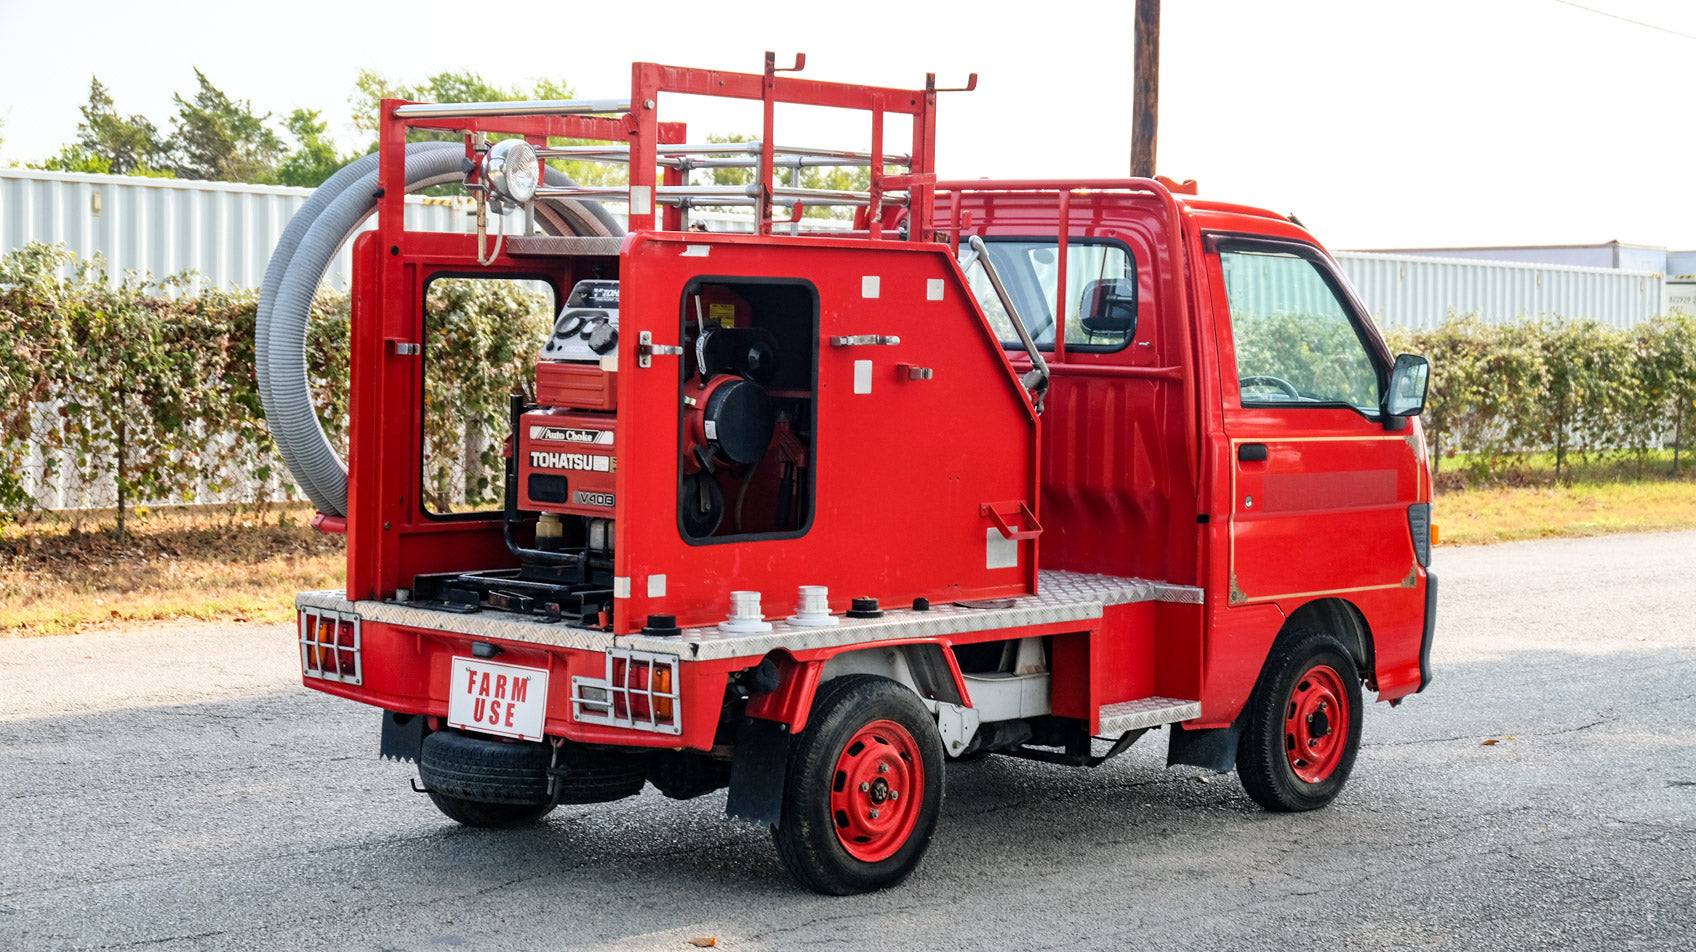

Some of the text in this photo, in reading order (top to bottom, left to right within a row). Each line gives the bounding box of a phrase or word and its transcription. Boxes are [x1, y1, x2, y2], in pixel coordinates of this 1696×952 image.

[545, 430, 593, 442] Auto Choke
[530, 451, 593, 471] TOHATSU
[580, 493, 614, 506] V40B
[468, 671, 528, 703] FARM
[474, 698, 515, 728] USE
